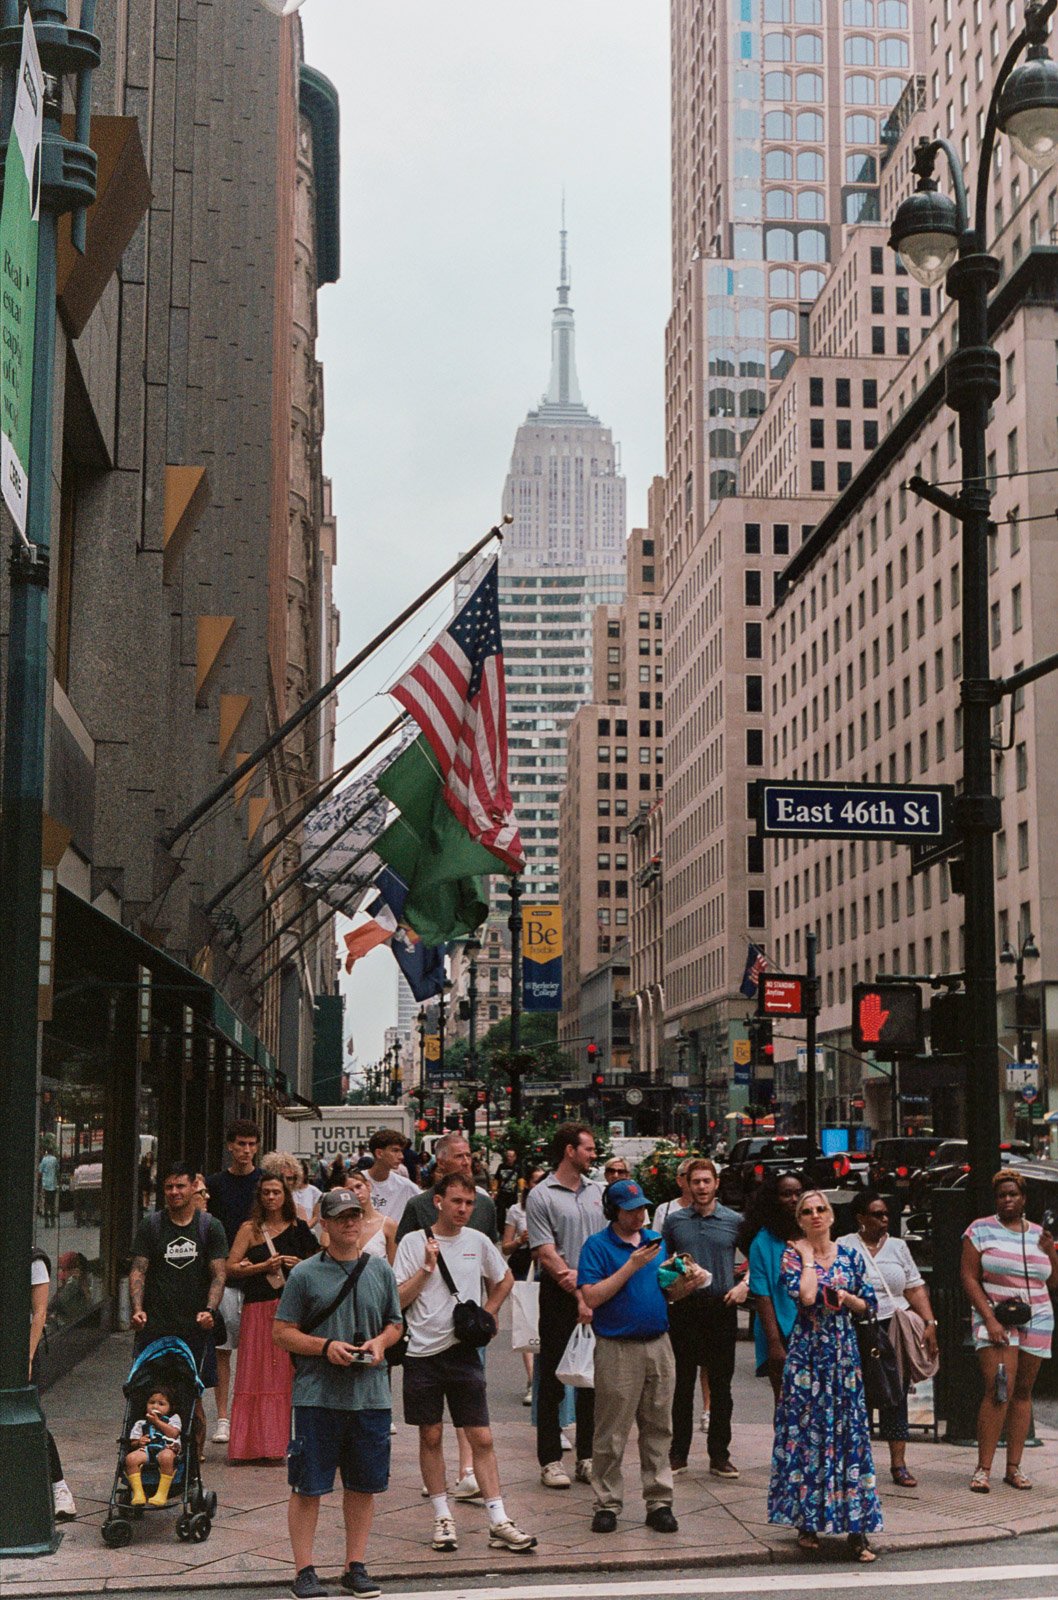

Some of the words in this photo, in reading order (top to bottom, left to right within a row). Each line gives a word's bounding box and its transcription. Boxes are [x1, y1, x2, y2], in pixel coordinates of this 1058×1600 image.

[4, 249, 22, 291] Real
[9, 460, 22, 499] CBRE
[776, 798, 834, 823] East
[840, 800, 896, 825] 46th
[903, 801, 931, 826] St
[527, 922, 558, 945] Be
[532, 982, 559, 991] Berkeley
[774, 981, 796, 989] STANDING
[533, 989, 557, 997] College
[766, 989, 785, 997] Anytime
[311, 1126, 376, 1139] TURTLE
[314, 1141, 371, 1154] HUGHE
